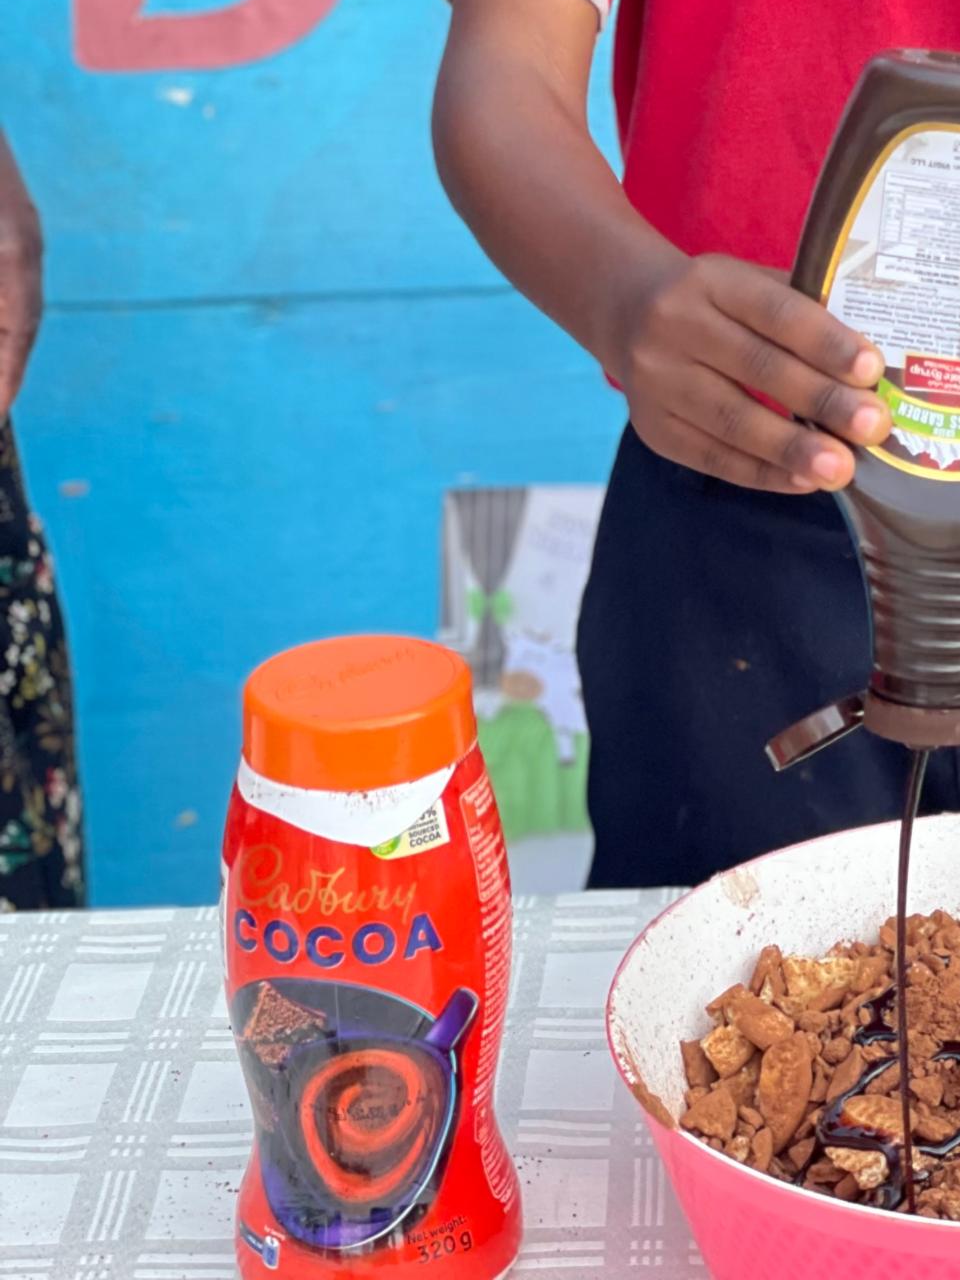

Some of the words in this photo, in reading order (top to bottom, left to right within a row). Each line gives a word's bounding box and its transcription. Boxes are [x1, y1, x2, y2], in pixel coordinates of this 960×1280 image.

[897, 401, 945, 428] GARDEN
[408, 823, 440, 839] SOURCED
[409, 831, 441, 848] COCOA
[237, 843, 418, 926] Cadbury
[234, 908, 445, 969] COCOA
